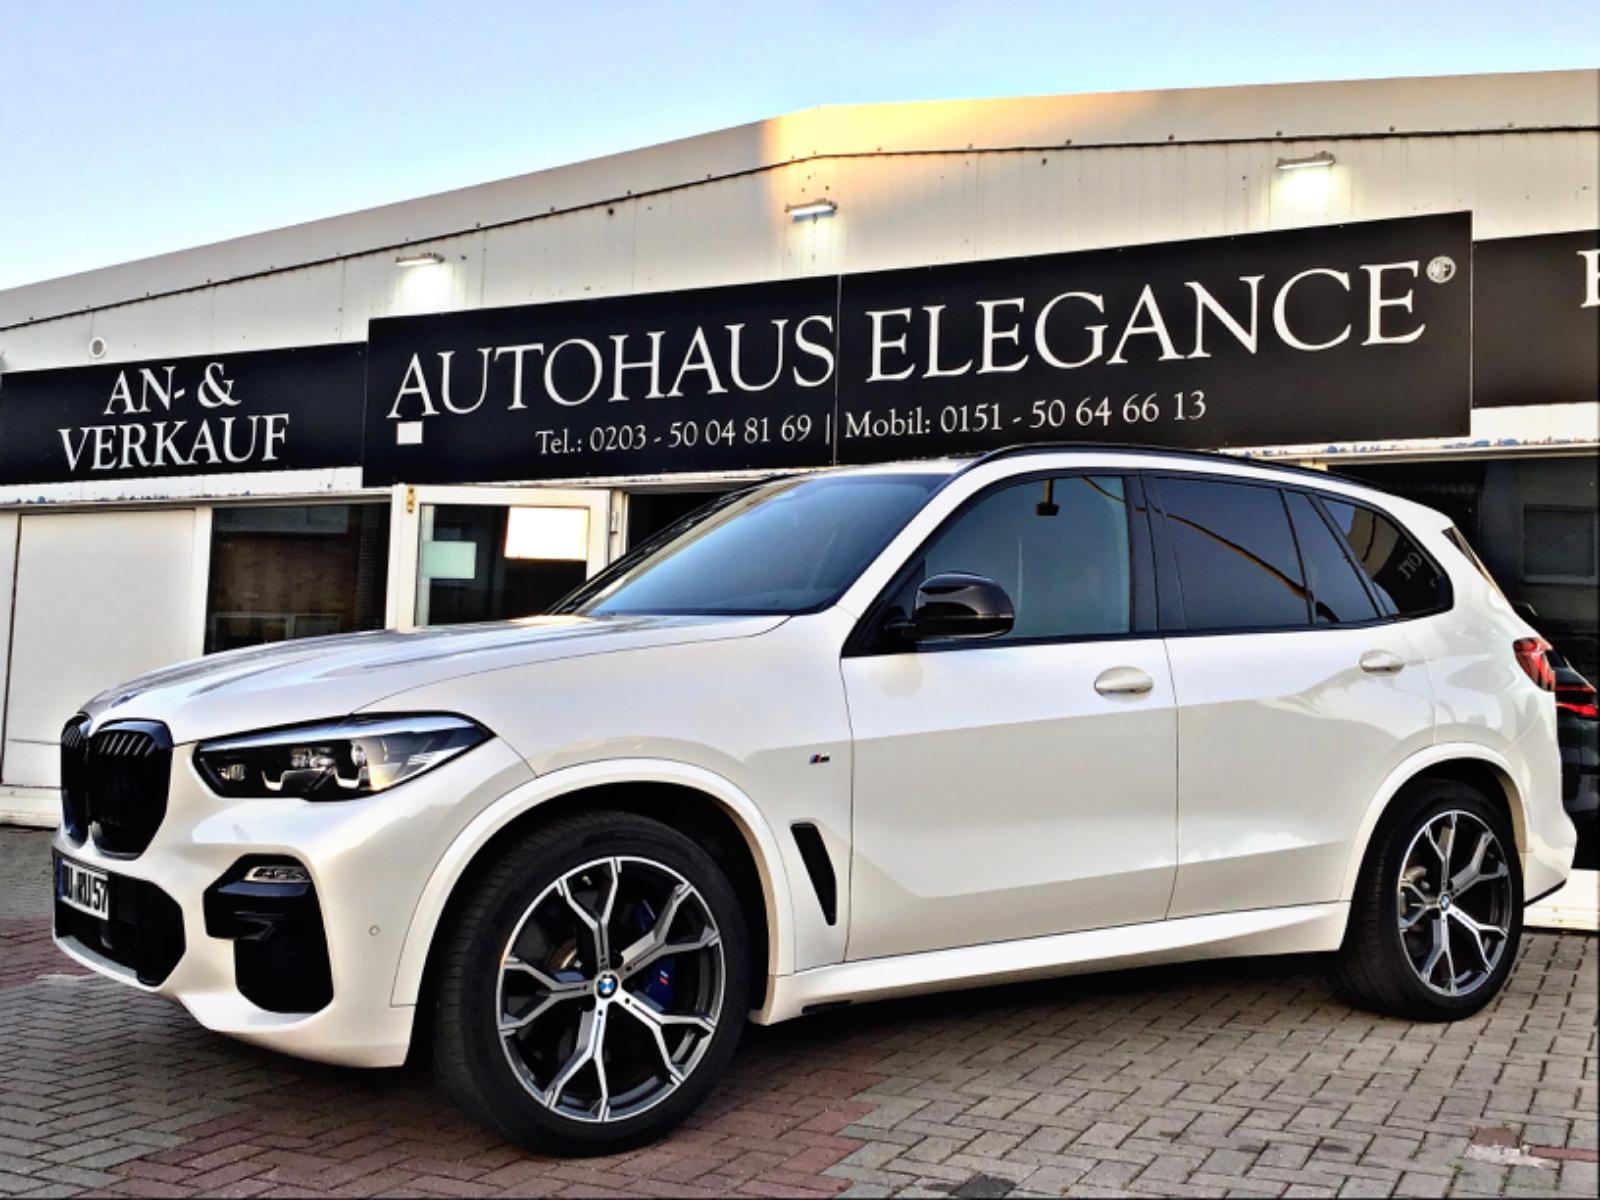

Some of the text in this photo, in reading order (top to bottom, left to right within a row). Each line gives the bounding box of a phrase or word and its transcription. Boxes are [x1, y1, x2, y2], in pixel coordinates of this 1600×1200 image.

[386, 259, 1426, 420] AUTOHAUS ELEGANCE
[103, 362, 242, 415] AN- &
[57, 413, 290, 471] VERKAUF
[535, 427, 582, 454] Tel.:
[589, 424, 647, 452] 0203
[668, 420, 699, 448] 50
[705, 419, 736, 446] 04
[744, 417, 770, 444] 81
[781, 415, 812, 443] 69
[845, 406, 931, 438] Mobil:
[940, 403, 1002, 433] 0151
[1029, 399, 1066, 429] 50
[1075, 396, 1113, 426] 64
[1122, 393, 1160, 423] 66
[1174, 390, 1207, 421] 13
